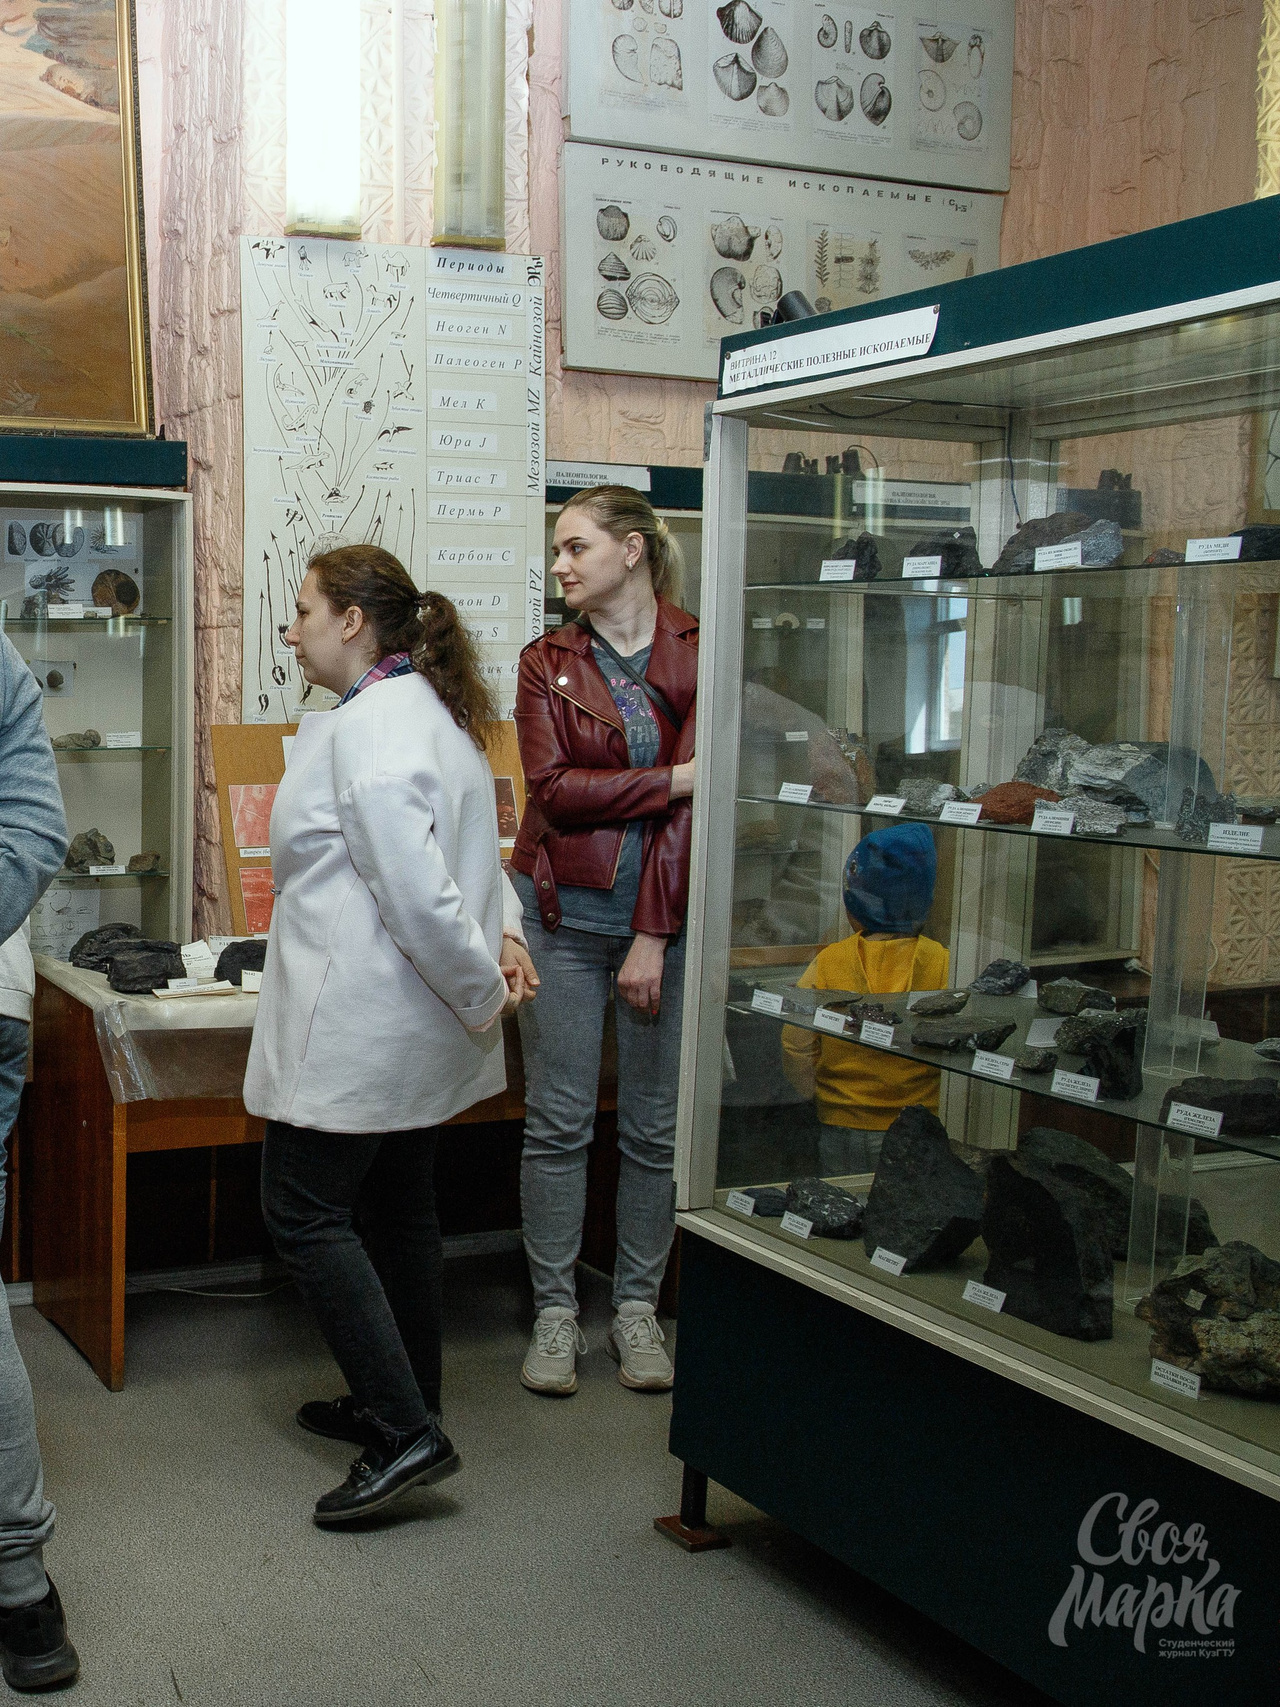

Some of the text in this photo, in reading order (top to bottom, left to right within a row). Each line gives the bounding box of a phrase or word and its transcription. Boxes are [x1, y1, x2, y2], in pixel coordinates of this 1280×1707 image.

[602, 157, 932, 203] РУКОВОДЯЩИЕ ИСКОПАЕМЫЕ
[437, 257, 505, 274] Периоды
[427, 287, 522, 307] Четвертичный Q
[436, 321, 507, 335] Неоген N
[529, 296, 543, 377] Кайнозой
[434, 353, 506, 369] Палеоген
[729, 332, 931, 384] МЕТАЛЛИЧЕСКИЕ ПОЛЕЗНЫЕ ИСКОПАЕМЫЕ
[730, 351, 777, 372] ВИТРИНА 12
[440, 396, 467, 409] Мел
[439, 434, 487, 449] Юра J
[527, 387, 540, 492] Мезозой MZ
[437, 471, 481, 485] Триас
[437, 504, 485, 519] Пермь
[437, 549, 493, 564] Карбон
[529, 568, 543, 592] PZ
[491, 595, 501, 606] D
[491, 626, 499, 638] S
[1176, 1109, 1216, 1123] РУДА ЖЕЛЕЗА
[1155, 1365, 1180, 1379] ОСТАТКИ
[1183, 1382, 1197, 1392] РУДЫ
